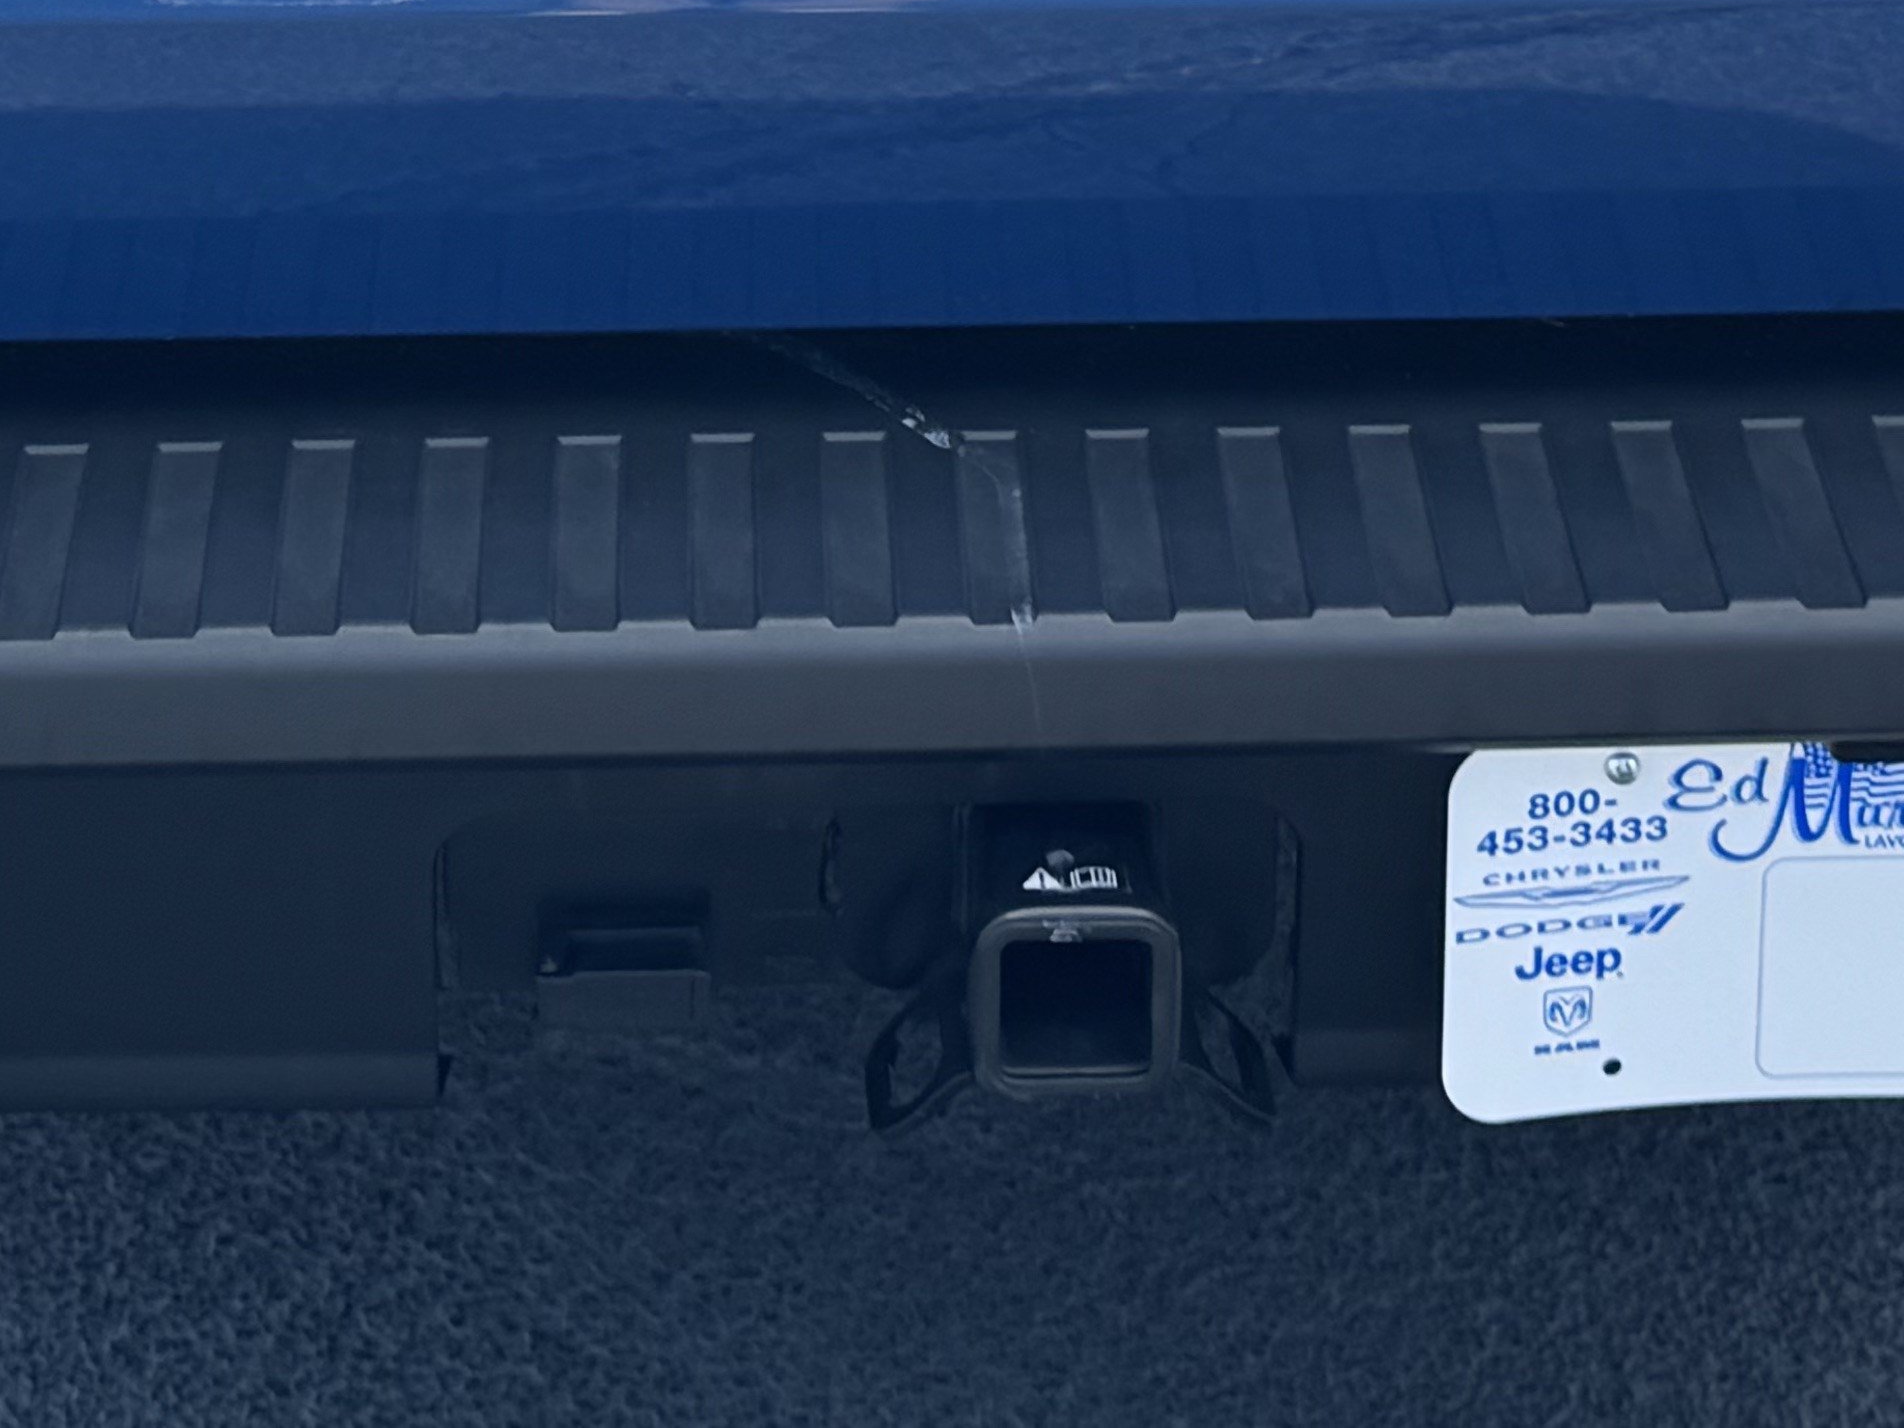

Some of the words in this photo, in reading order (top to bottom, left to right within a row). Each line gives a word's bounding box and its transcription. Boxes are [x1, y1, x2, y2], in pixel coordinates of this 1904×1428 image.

[1662, 758, 1769, 811] Ed
[1527, 788, 1618, 820] 800-
[1476, 815, 1669, 857] 453-3433
[1482, 858, 1661, 887] CHRYSLER
[1455, 911, 1650, 944] DODGE
[1514, 945, 1622, 981] Jeep
